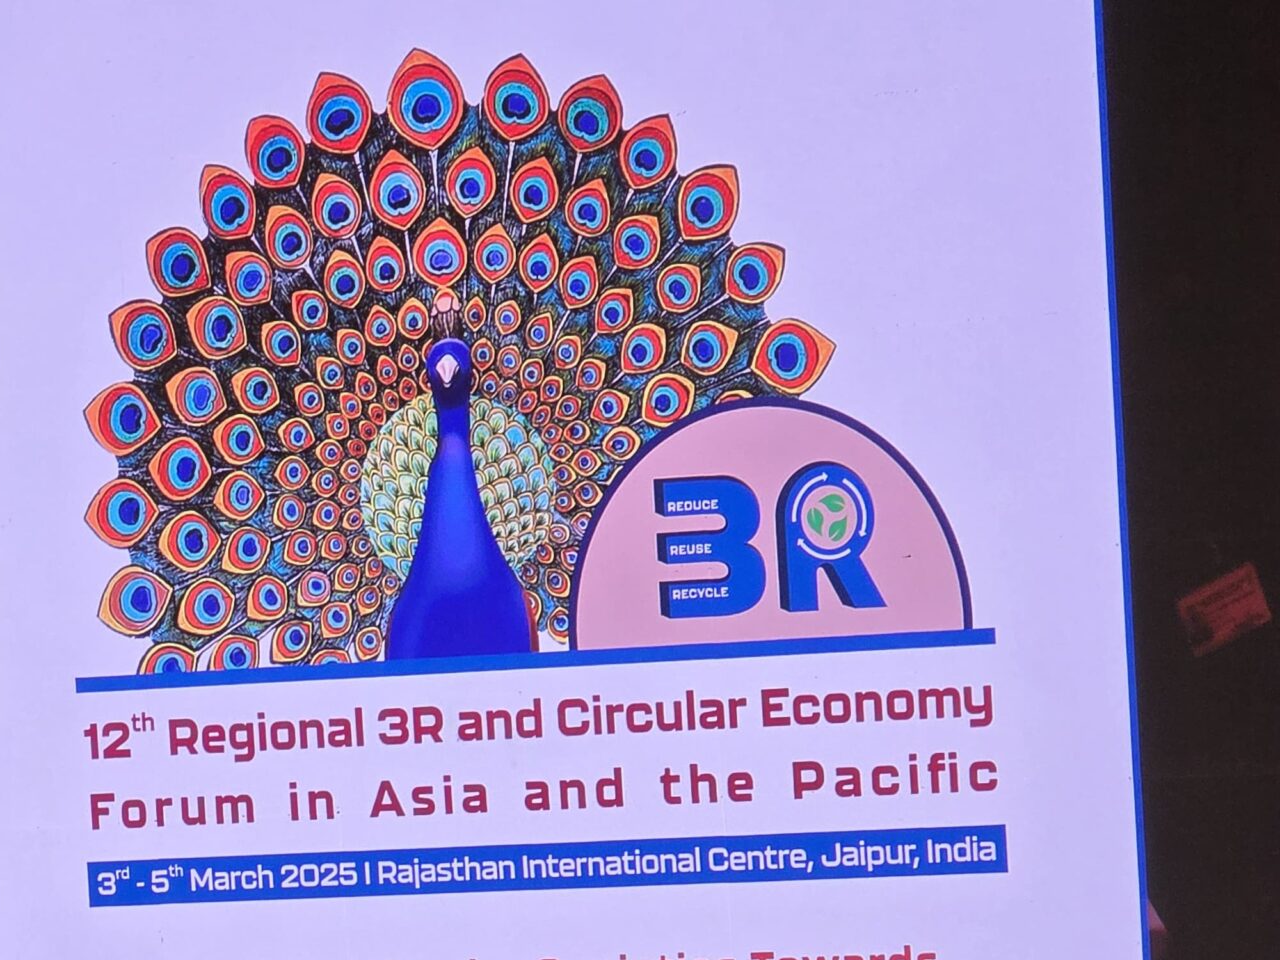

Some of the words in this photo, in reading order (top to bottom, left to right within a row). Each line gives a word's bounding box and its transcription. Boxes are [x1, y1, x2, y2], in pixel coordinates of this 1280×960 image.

[667, 499, 719, 512] REDUCE
[670, 543, 712, 556] REUSE
[672, 587, 729, 600] RECYCLE
[167, 706, 365, 762] Regional
[376, 705, 444, 746] 3R
[456, 696, 543, 742] and
[556, 688, 747, 737] Circular
[759, 684, 993, 728] Economy
[89, 791, 255, 831] Forum
[288, 780, 337, 822] in
[368, 773, 488, 818] Asia
[523, 766, 624, 811] and
[658, 762, 754, 805] the
[791, 750, 998, 800] Pacific
[189, 863, 274, 892] March
[279, 861, 358, 888] 2025
[376, 854, 516, 889] Rajasthan
[521, 845, 701, 879] International
[707, 844, 814, 873] Centre,
[820, 839, 920, 872] Jaipur,
[926, 834, 997, 864] India
